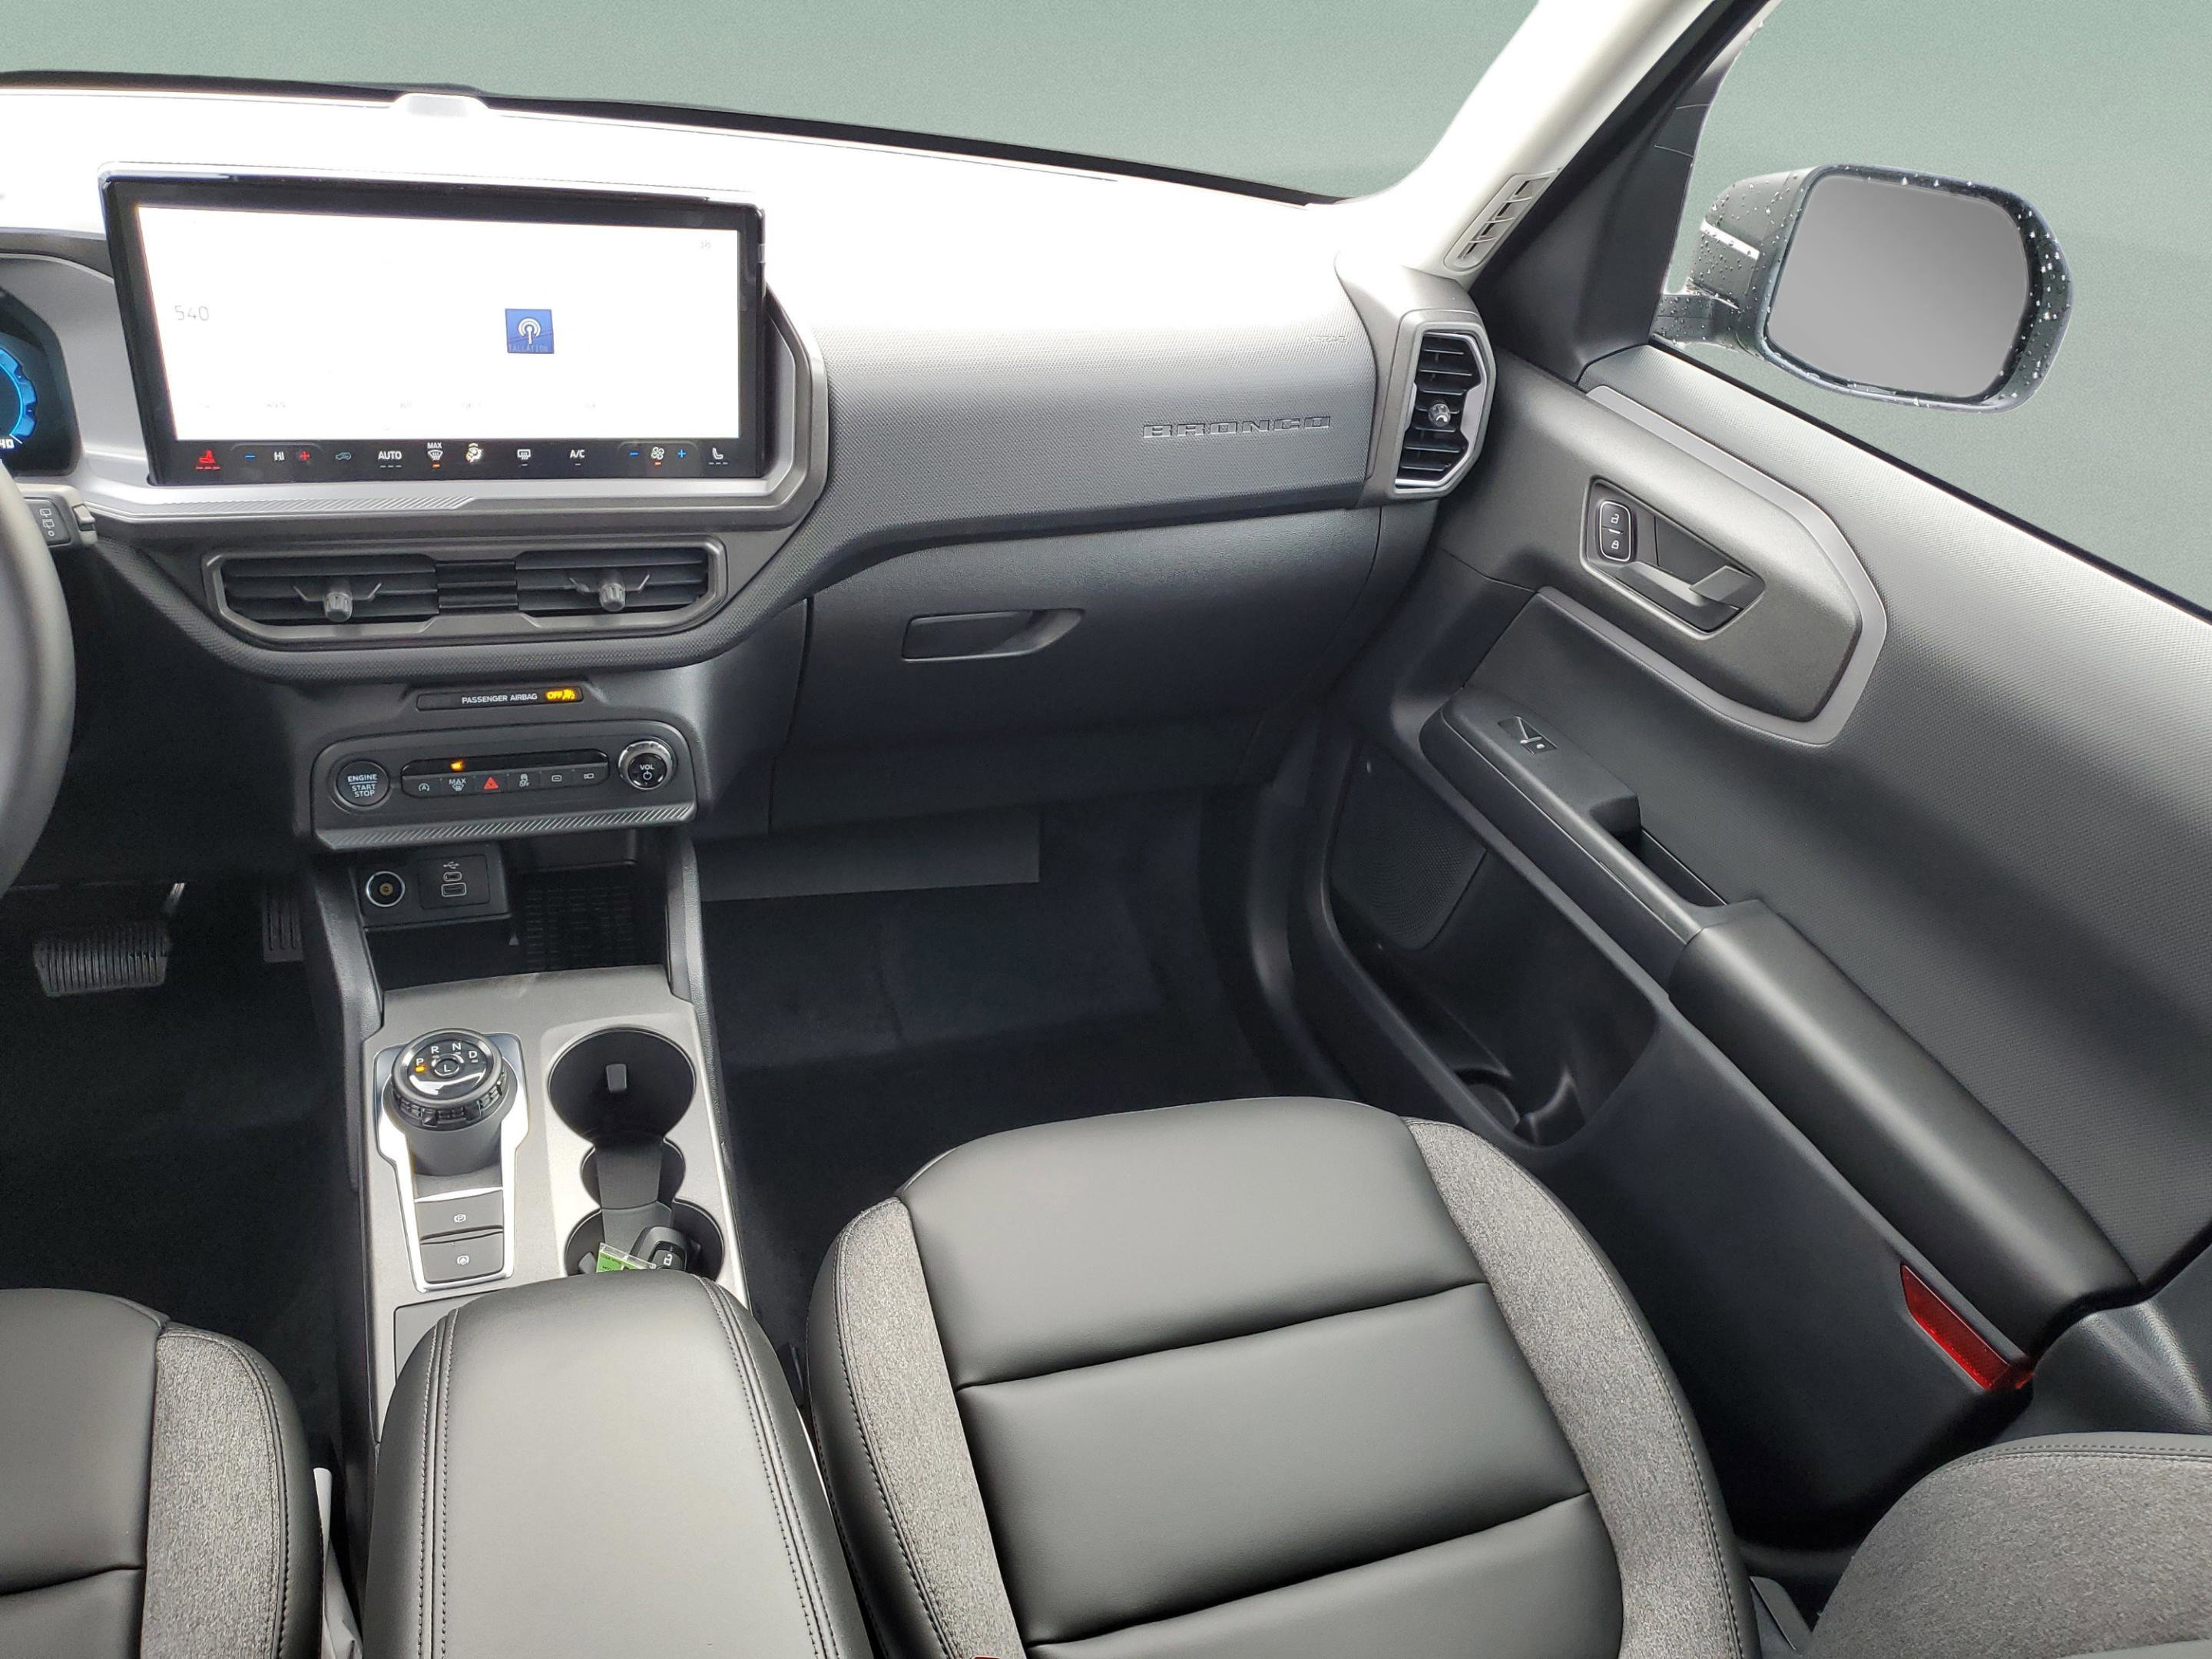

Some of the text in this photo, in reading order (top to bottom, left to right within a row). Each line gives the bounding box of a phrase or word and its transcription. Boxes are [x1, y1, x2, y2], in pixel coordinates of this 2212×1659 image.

[174, 305, 210, 321] 540
[1143, 416, 1331, 439] BRONCO
[273, 451, 285, 461] HI
[378, 450, 402, 460] AUTO
[570, 449, 585, 459] A/C
[462, 690, 563, 704] PASSENGER AIRBAG OFF
[347, 773, 378, 782] ENGINE
[354, 790, 376, 798] STOP
[416, 1058, 424, 1066] P
[431, 1045, 439, 1054] R
[452, 1042, 462, 1051] N
